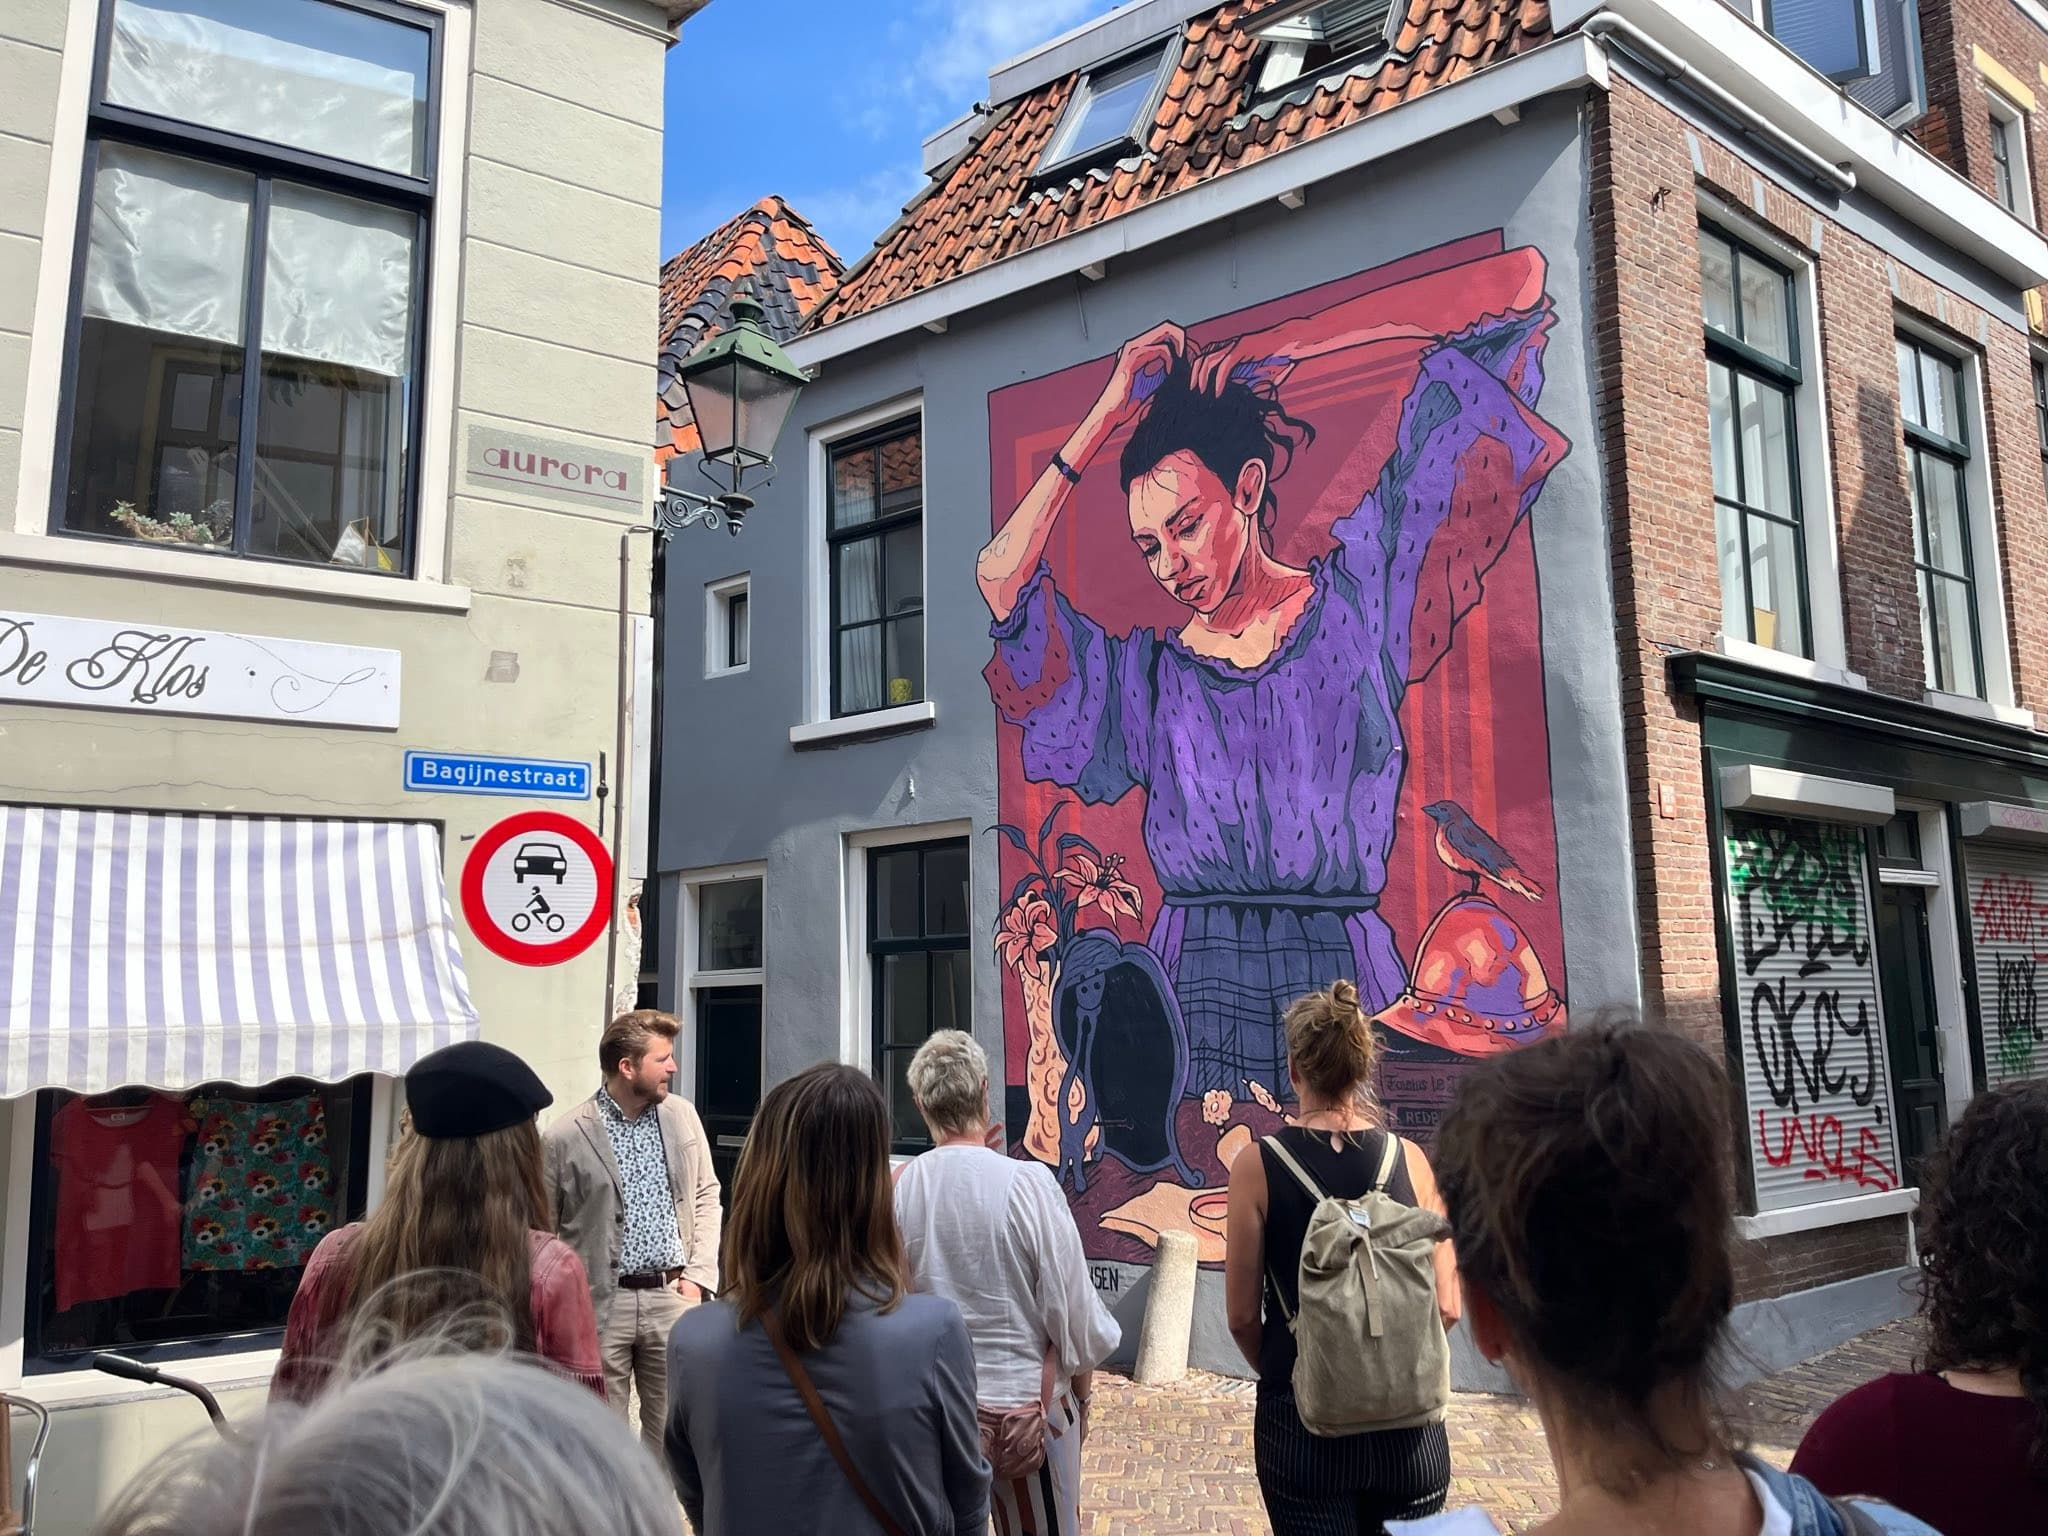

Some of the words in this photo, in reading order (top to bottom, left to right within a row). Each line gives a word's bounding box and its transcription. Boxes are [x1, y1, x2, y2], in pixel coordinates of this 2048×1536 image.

[483, 448, 627, 491] aurora
[0, 618, 47, 685] De
[66, 630, 209, 704] Klos
[422, 761, 577, 786] Bagijnestraat
[1404, 1110, 1441, 1126] REDB
